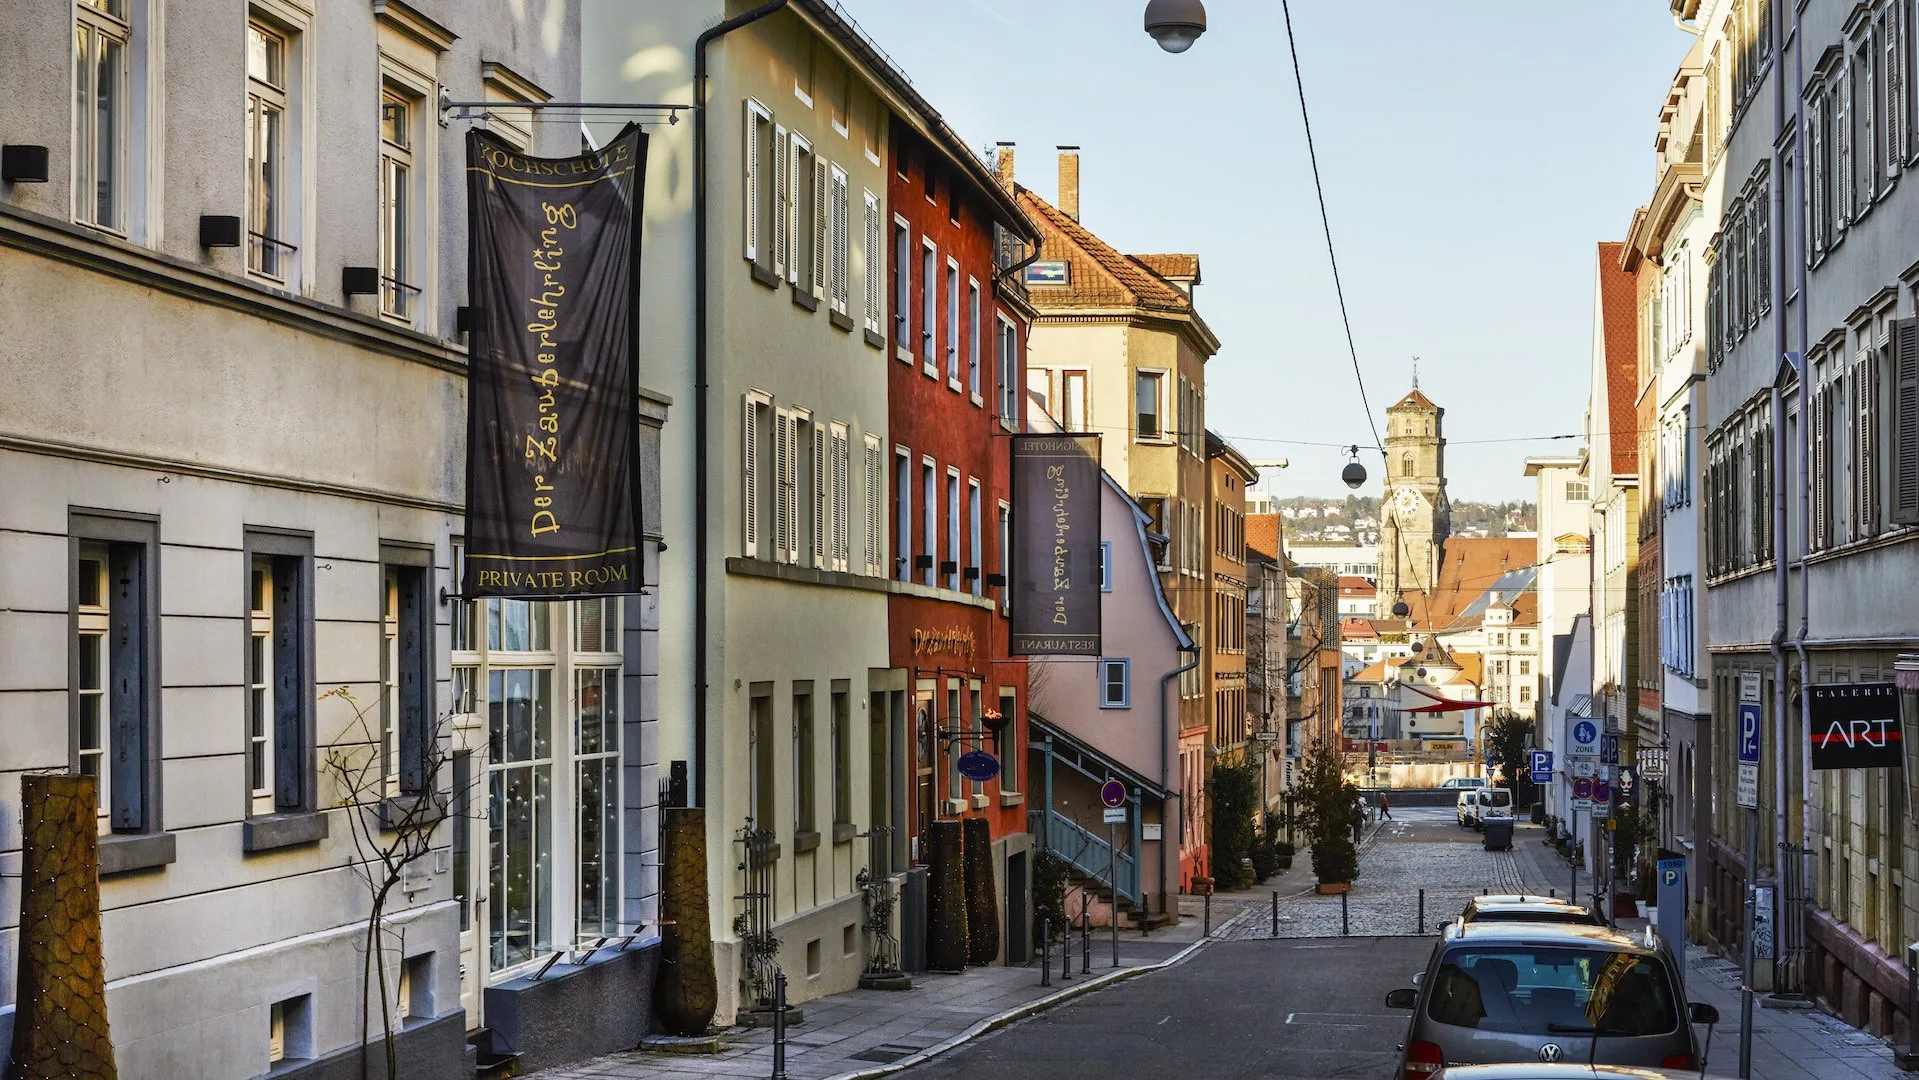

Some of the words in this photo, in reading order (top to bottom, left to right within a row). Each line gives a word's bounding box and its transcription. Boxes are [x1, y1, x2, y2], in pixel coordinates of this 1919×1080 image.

[524, 201, 577, 463] Zauberlehrling
[530, 475, 561, 538] Der
[478, 570, 566, 589] PRIVATE
[570, 564, 629, 588] ROOM
[1816, 687, 1894, 699] GALERIE
[1742, 711, 1756, 754] P
[1820, 718, 1895, 750] ART
[1575, 745, 1595, 753] ZONE
[1534, 753, 1547, 771] P
[1665, 870, 1677, 885] P
